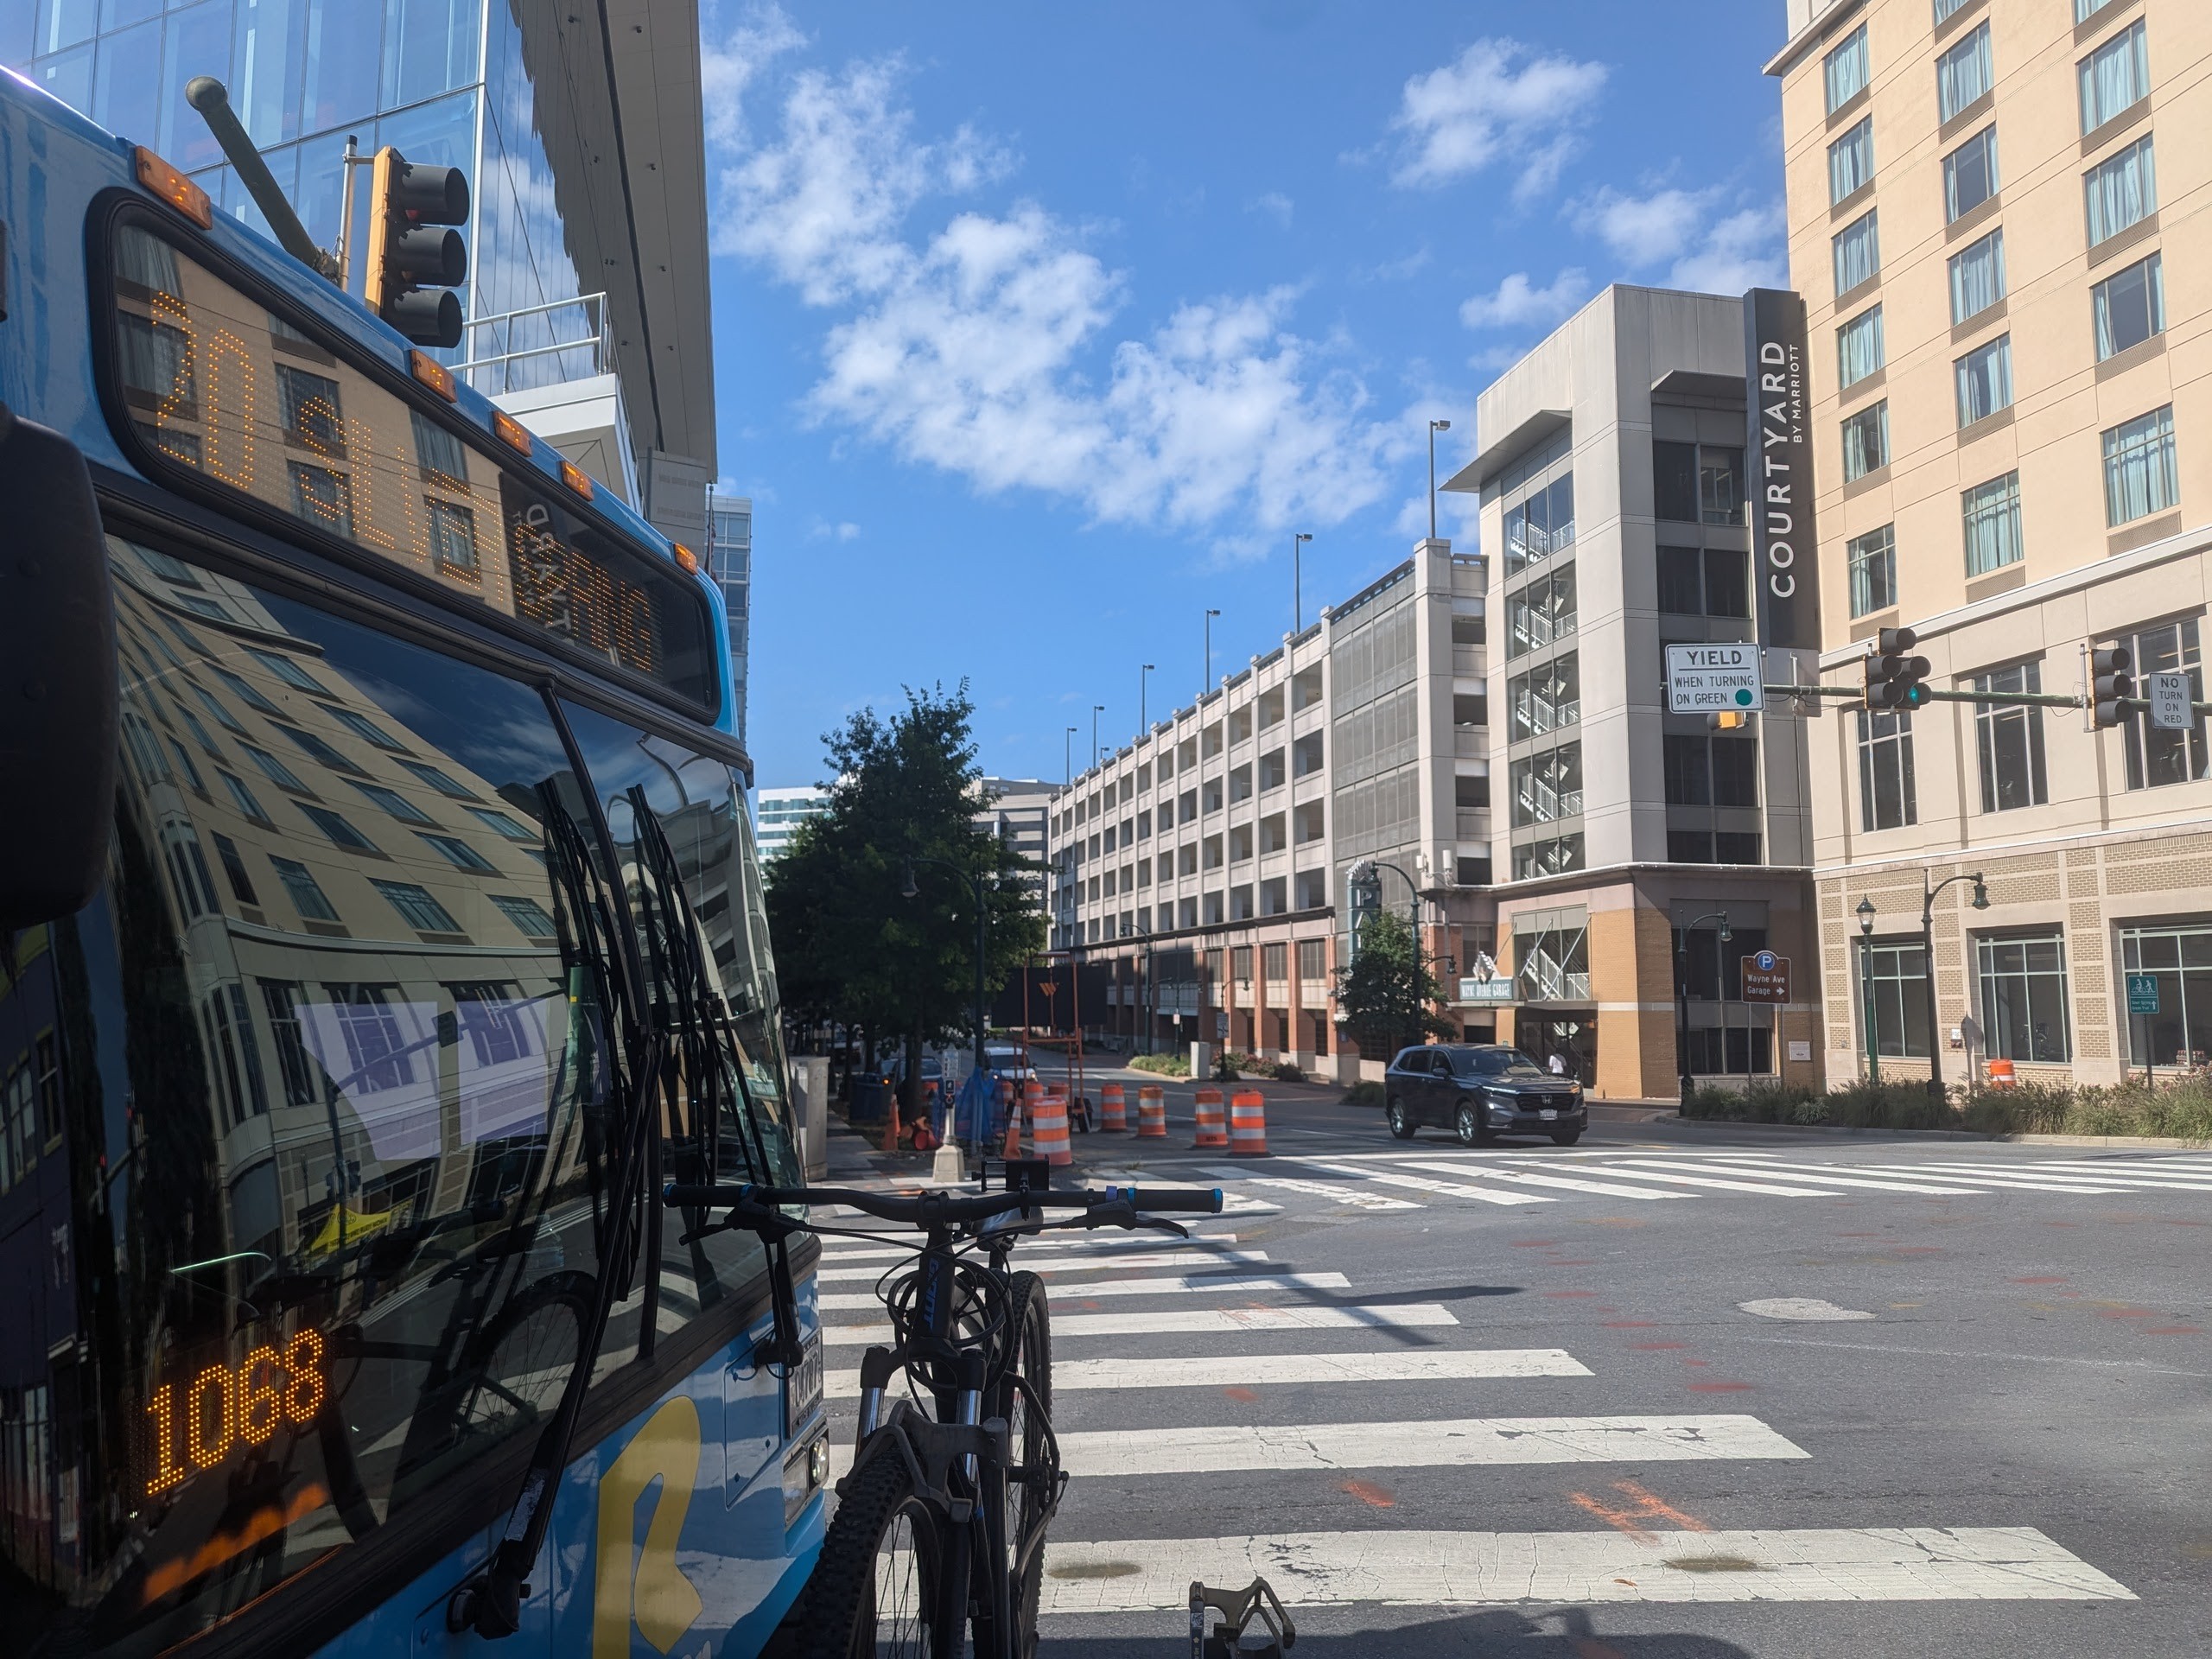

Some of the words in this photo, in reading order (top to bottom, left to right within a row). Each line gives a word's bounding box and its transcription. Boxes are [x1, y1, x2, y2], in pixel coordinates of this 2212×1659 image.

[1789, 344, 1802, 419] MARRIOTT
[1792, 424, 1802, 443] BY
[1760, 341, 1796, 598] COURTYARD
[151, 290, 256, 491] 20
[299, 395, 504, 603] SILVER
[514, 522, 652, 672] SPRING
[1686, 650, 1743, 665] YIELD
[1675, 677, 1704, 688] WHEN
[1709, 675, 1754, 687] TURNING
[2160, 677, 2179, 688] NO
[1676, 693, 1690, 704] ON
[1694, 692, 1728, 704] GREEN
[2158, 690, 2183, 700] TURN
[2165, 702, 2179, 711] ON
[2164, 715, 2183, 723] RED
[1762, 955, 1772, 968] P
[1747, 975, 1770, 983] Wayne
[1772, 975, 1785, 983] Ave
[1492, 983, 1510, 997] GARAGE
[1747, 985, 1771, 995] Garage
[146, 1328, 324, 1496] 1068
